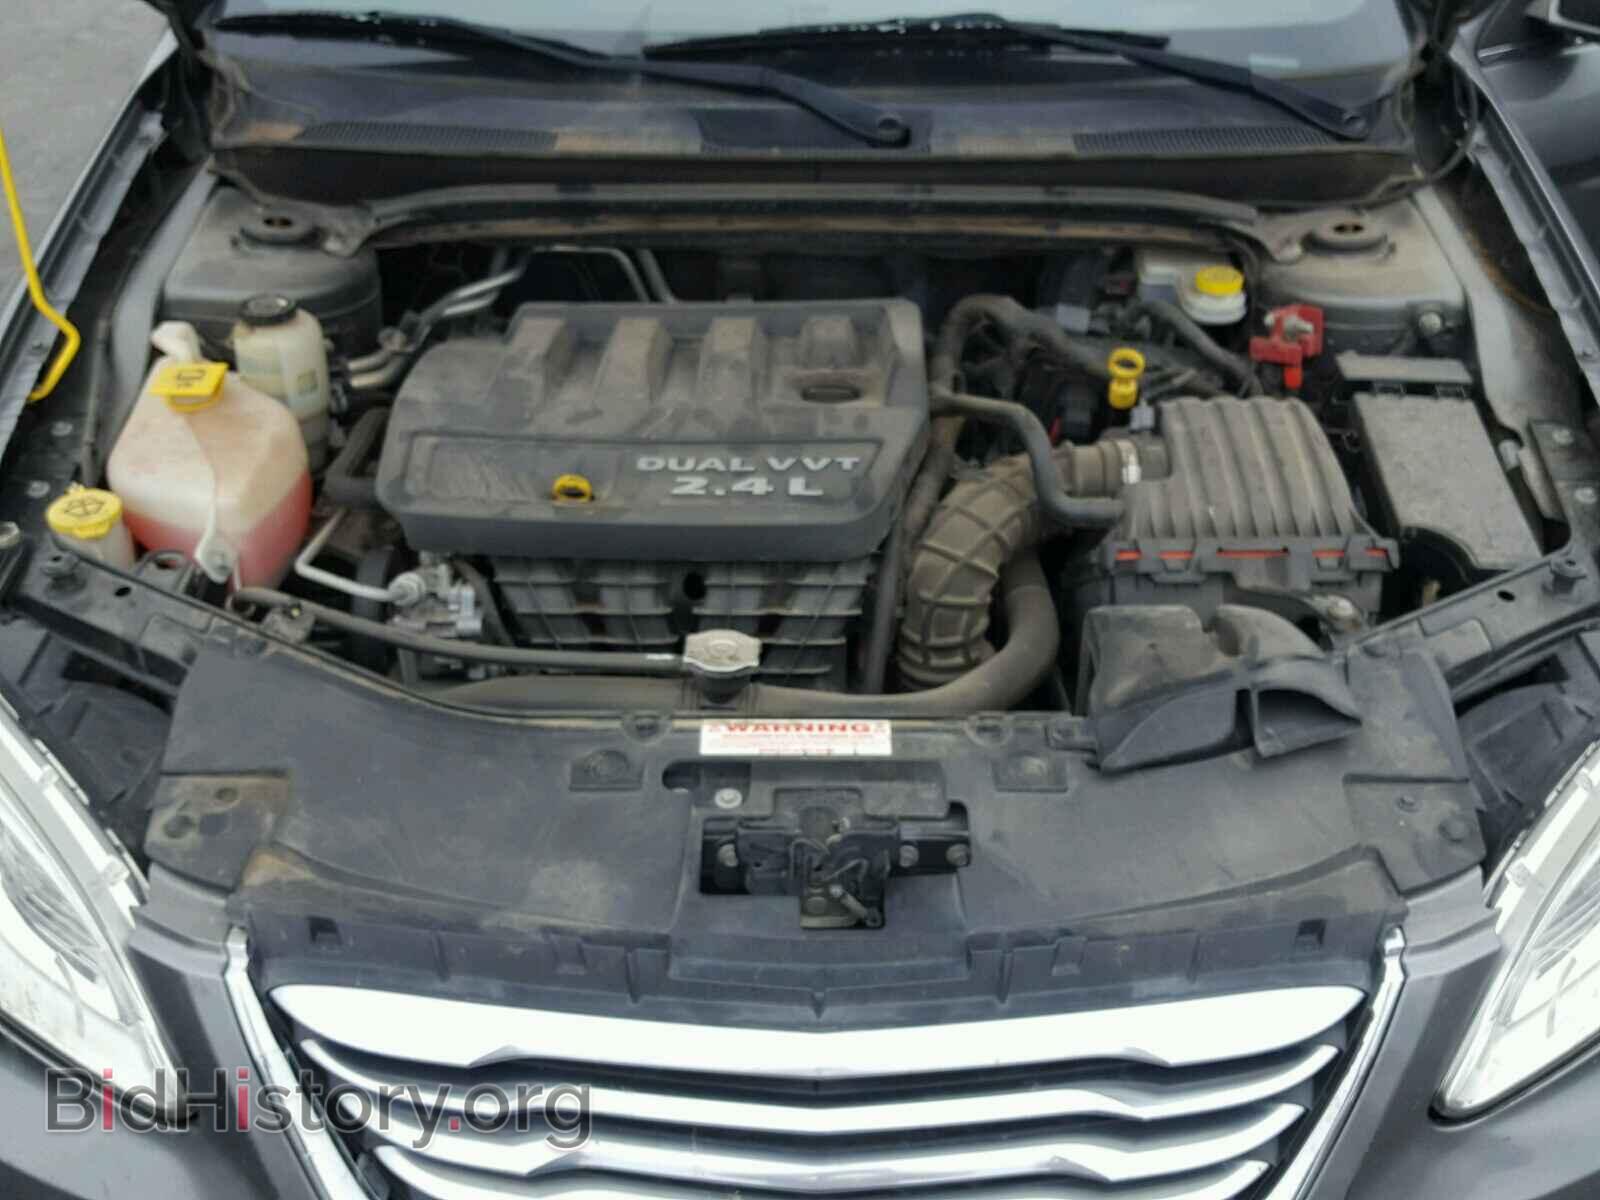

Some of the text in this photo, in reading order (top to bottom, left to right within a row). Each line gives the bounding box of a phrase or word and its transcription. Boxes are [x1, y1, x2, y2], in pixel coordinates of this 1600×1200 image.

[636, 457, 860, 472] DUAL VVT
[727, 722, 870, 733] WARNING
